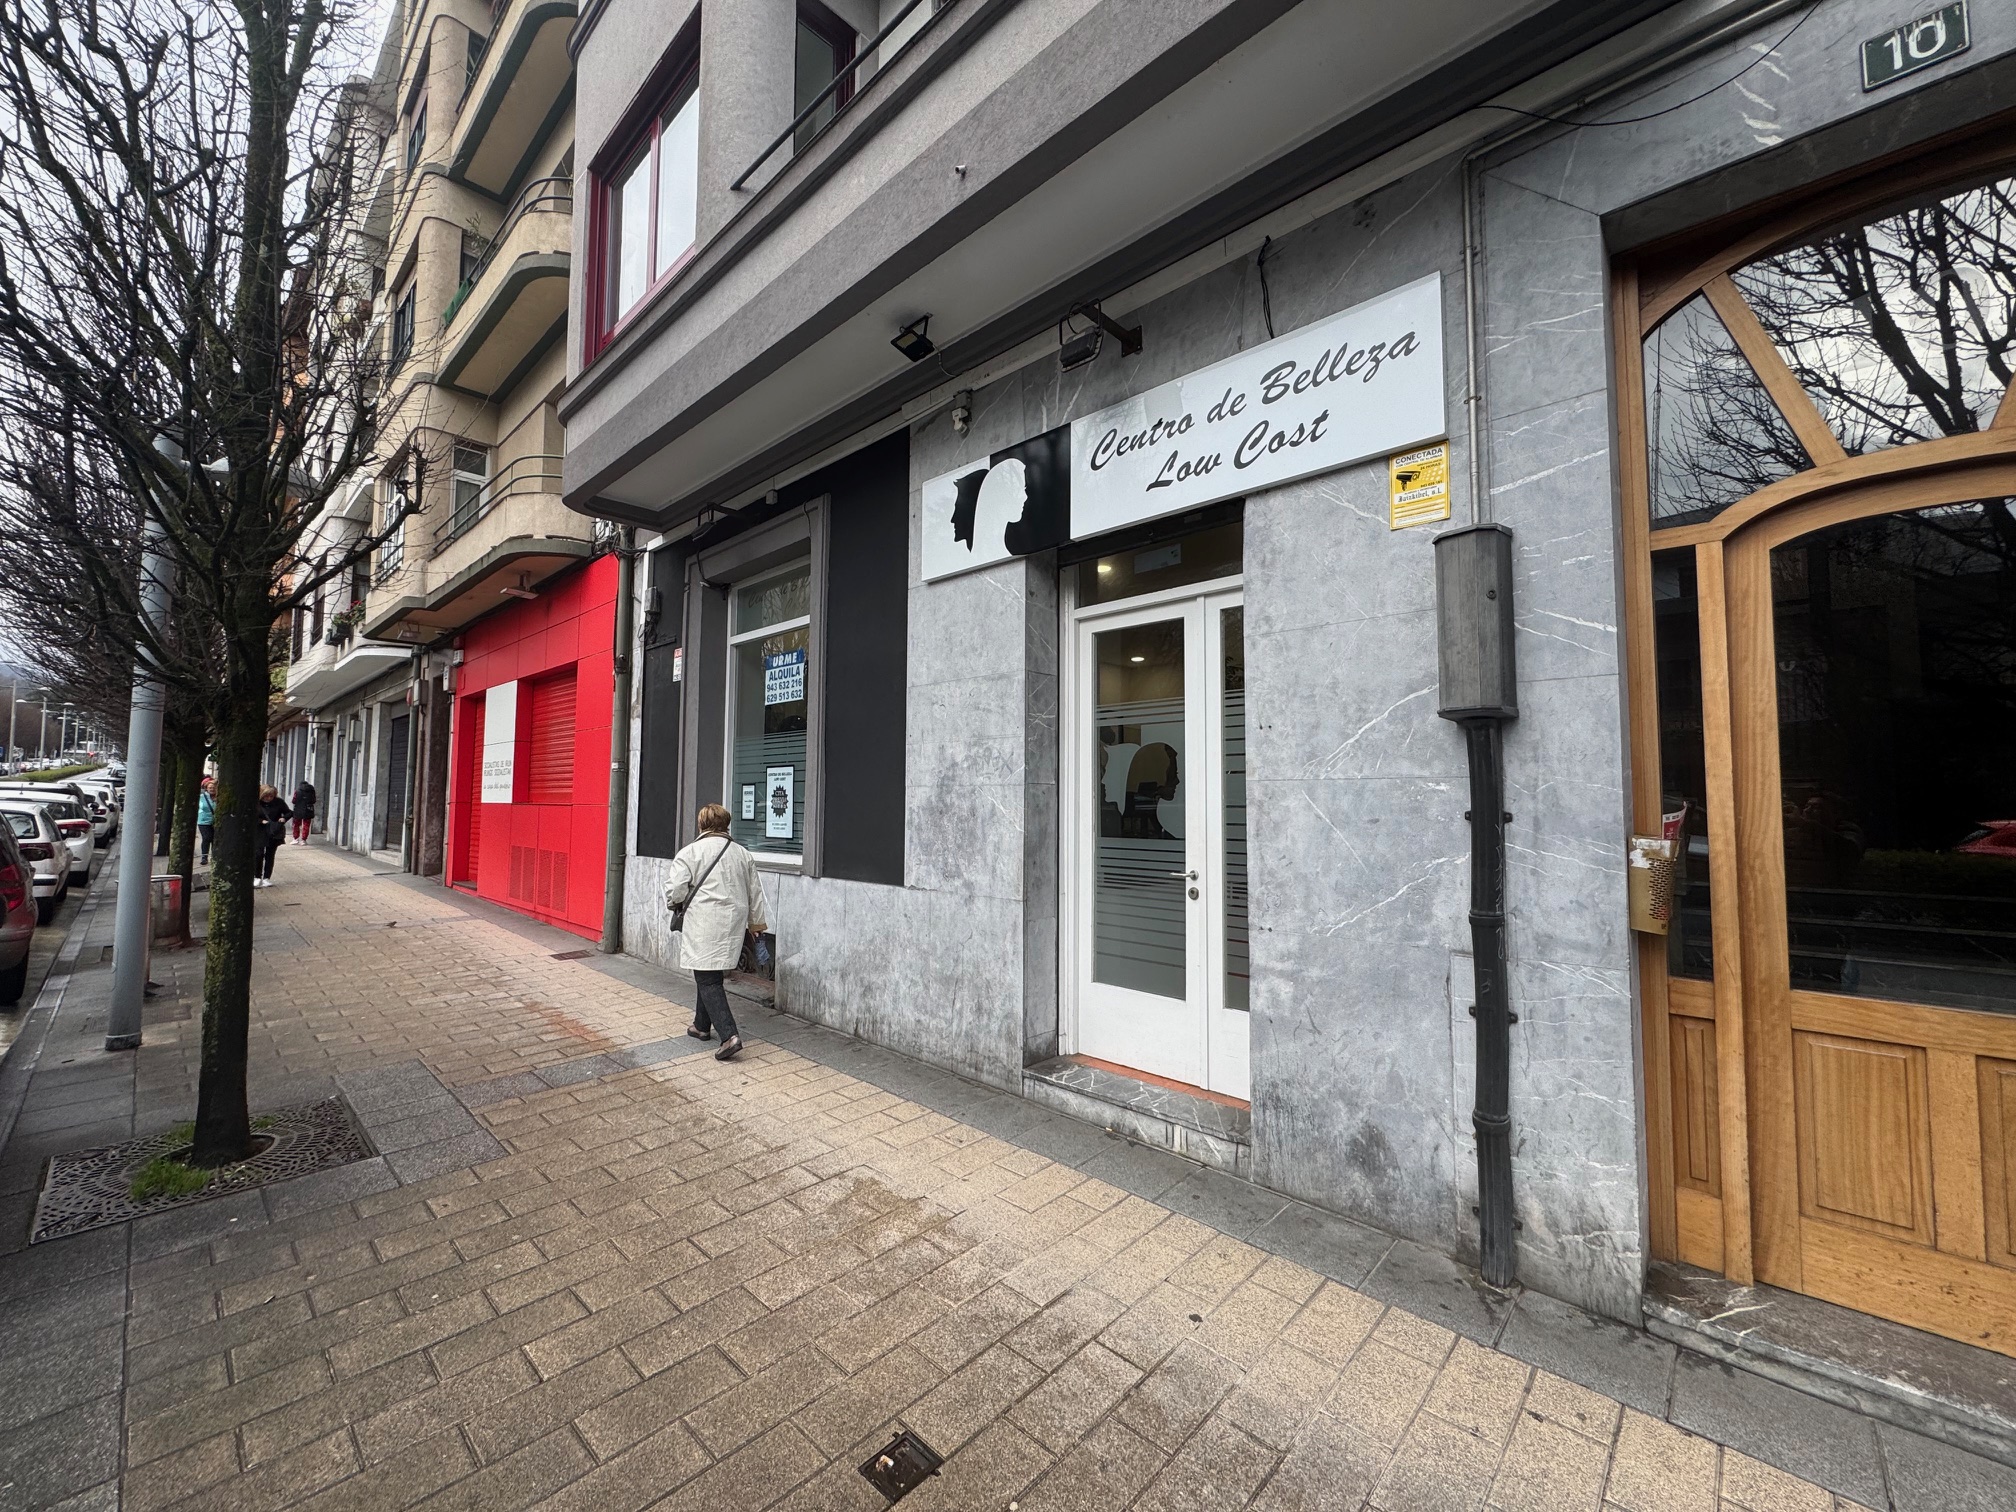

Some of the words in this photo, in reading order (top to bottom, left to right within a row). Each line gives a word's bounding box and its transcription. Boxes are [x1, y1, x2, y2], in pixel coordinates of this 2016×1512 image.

[1883, 20, 1946, 70] 10
[1091, 413, 1195, 471] Centro
[1207, 388, 1248, 424] de
[1260, 331, 1421, 406] Belleza
[1145, 450, 1222, 492] Low
[1233, 409, 1330, 470] Cost
[1396, 448, 1442, 464] CONECTADA
[772, 652, 798, 668] URME
[769, 666, 800, 682] ALQUILA
[767, 683, 777, 692] 943
[779, 680, 790, 691] 632
[791, 678, 802, 688] 216
[767, 694, 777, 703] 629
[779, 691, 790, 701] 513
[791, 689, 802, 699] 632
